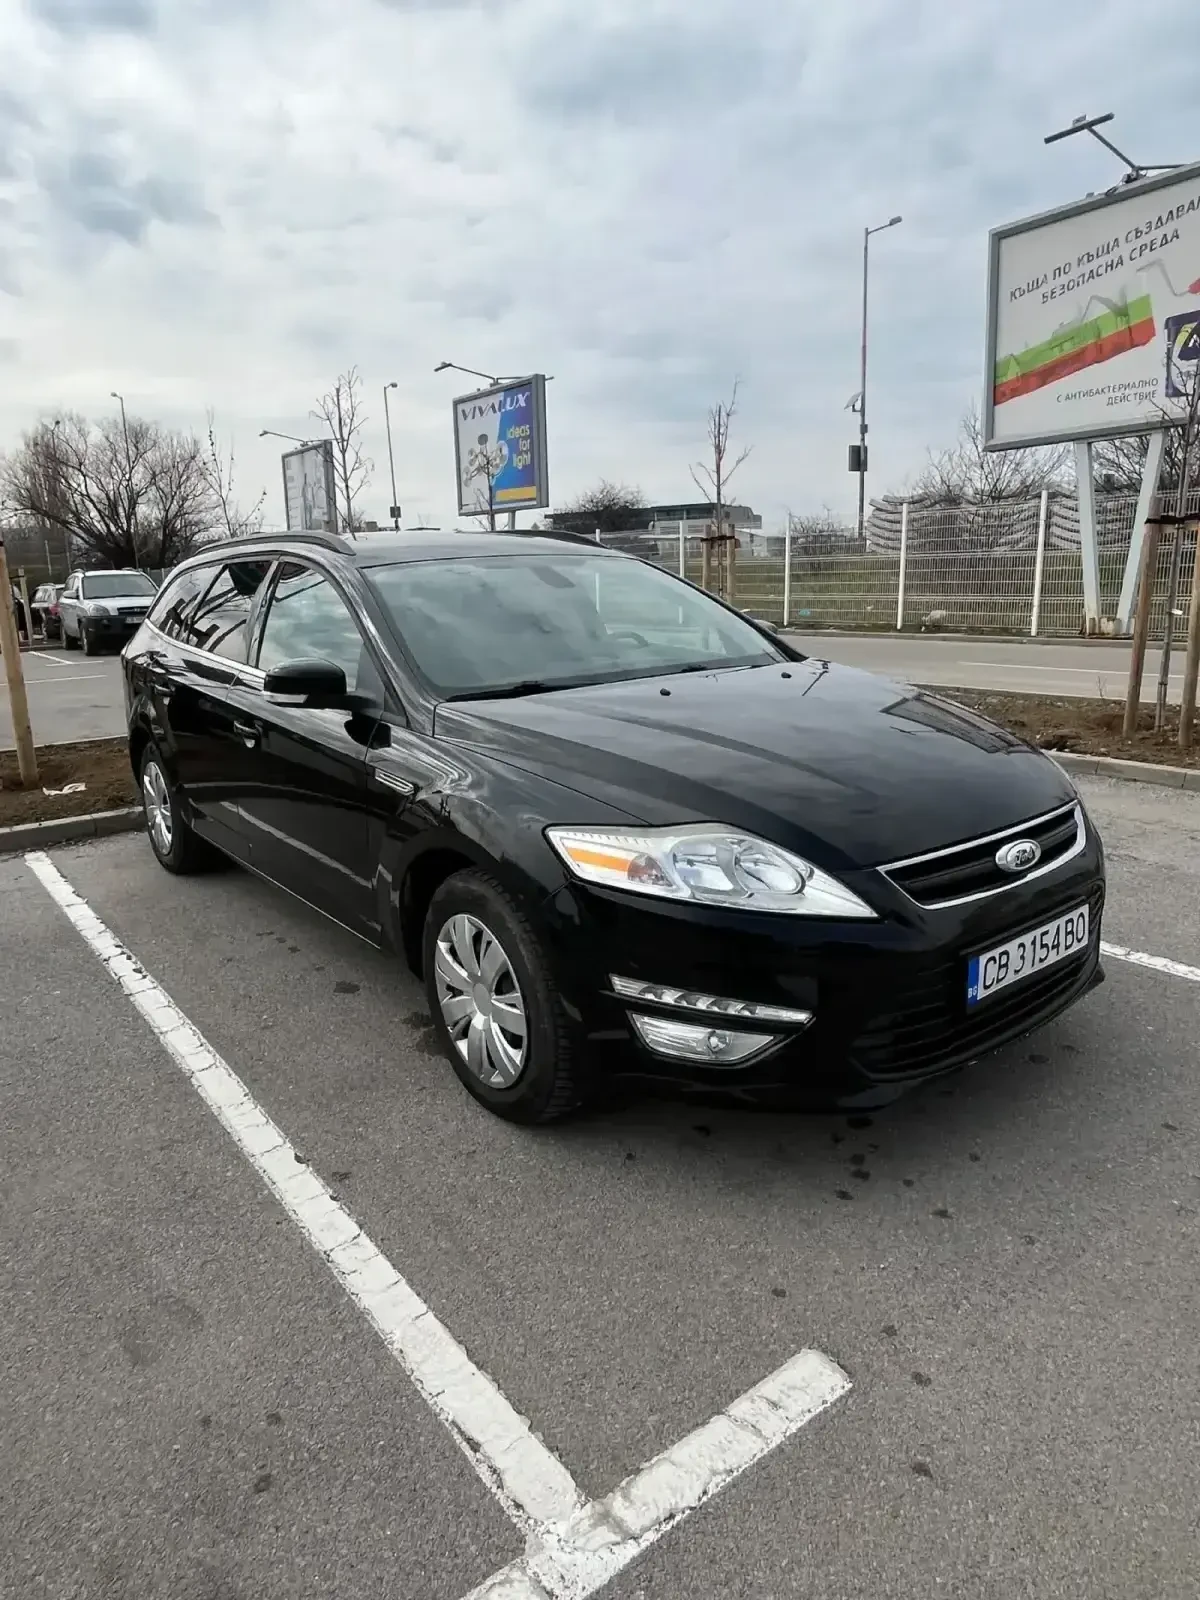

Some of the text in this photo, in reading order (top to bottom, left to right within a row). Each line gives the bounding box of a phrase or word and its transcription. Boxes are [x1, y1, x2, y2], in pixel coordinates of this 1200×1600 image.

[1009, 273, 1048, 302] КЪЩА
[1053, 262, 1072, 281] ПО
[1077, 237, 1120, 268] КЪЩА
[1041, 228, 1180, 304] БЕЗОПАСНА СРЕДА
[1064, 377, 1159, 401] АНТИБАКТЕРИАЛНО
[1106, 389, 1157, 406] ДЕЙСТВИЕ
[461, 391, 531, 421] VIVALUX
[507, 424, 530, 439] ideas
[519, 438, 531, 451] for
[512, 451, 531, 470] light
[1014, 923, 1060, 975] 3154
[967, 984, 978, 999] BG
